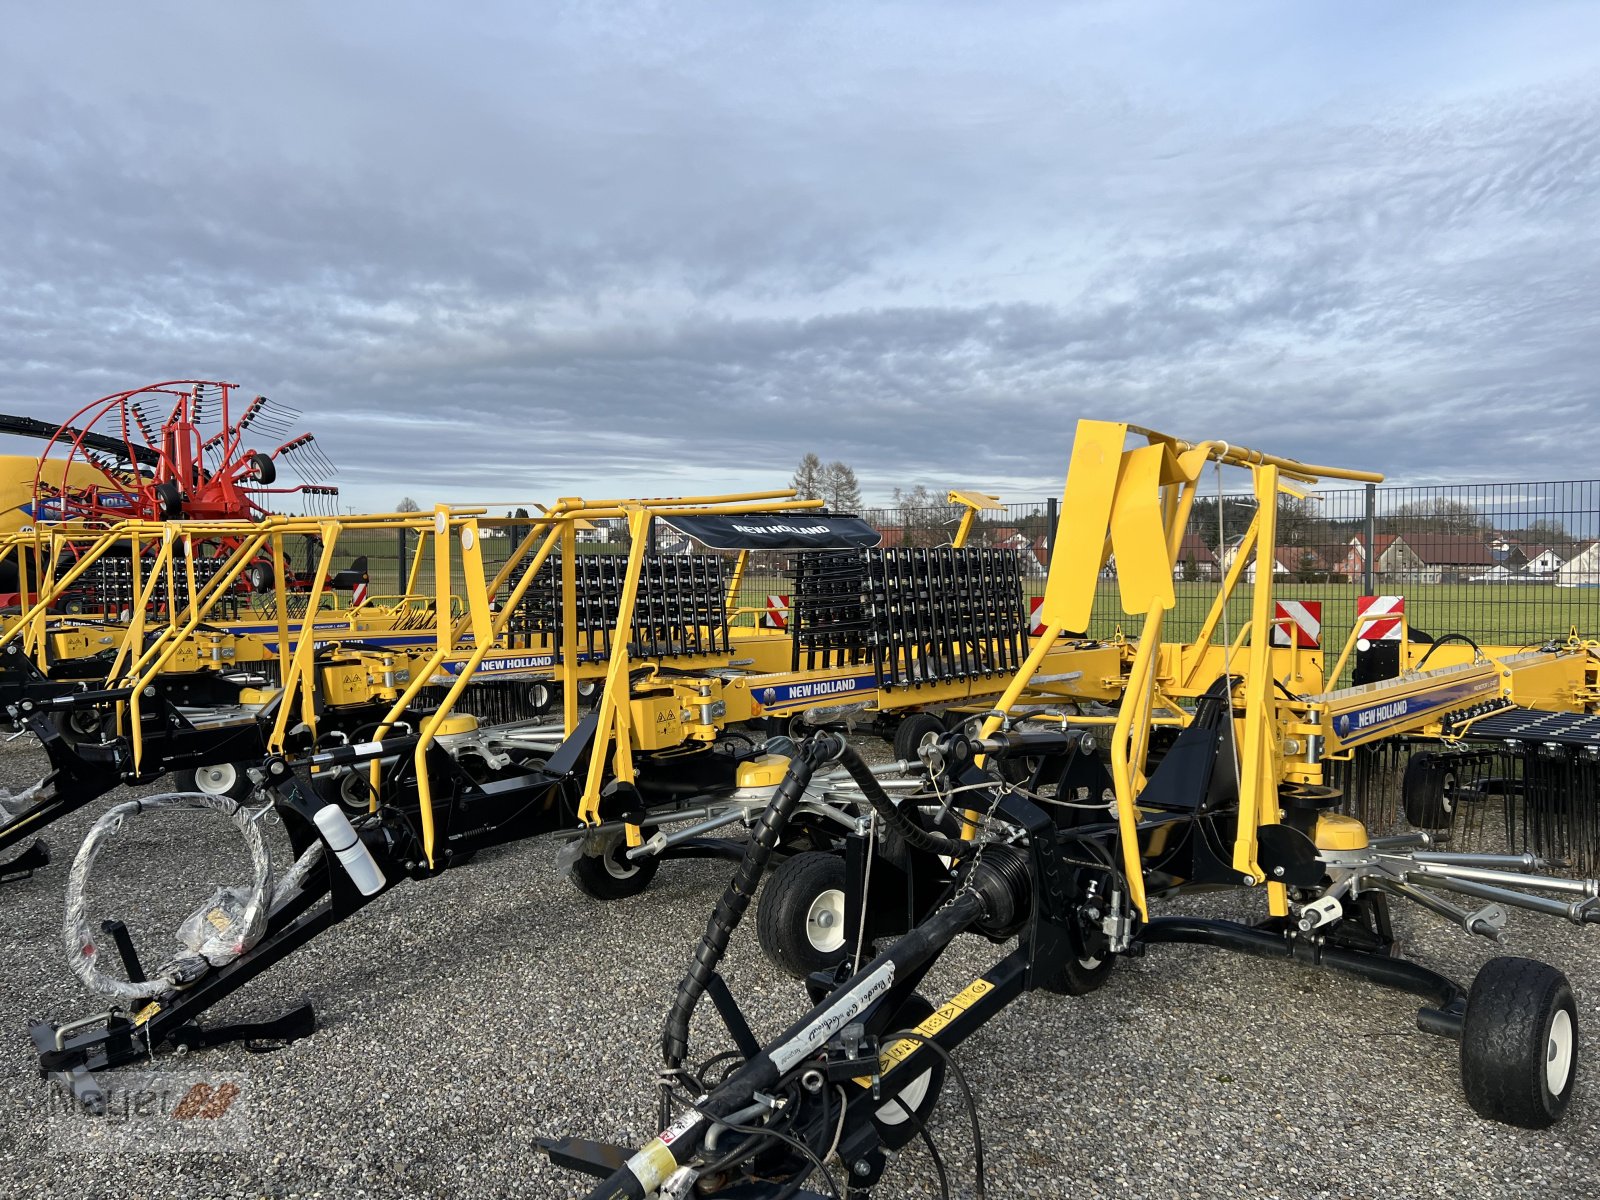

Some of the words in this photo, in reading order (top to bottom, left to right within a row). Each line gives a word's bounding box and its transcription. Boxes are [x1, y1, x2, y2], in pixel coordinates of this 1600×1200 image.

[732, 524, 768, 534] NEW
[767, 525, 831, 535] HOLLAND
[481, 660, 505, 671] NEW
[507, 656, 552, 669] HOLLAND
[789, 685, 812, 699] NEW
[813, 678, 856, 696] HOLLAND
[1358, 711, 1376, 728] NEW
[1376, 700, 1408, 723] HOLLAND
